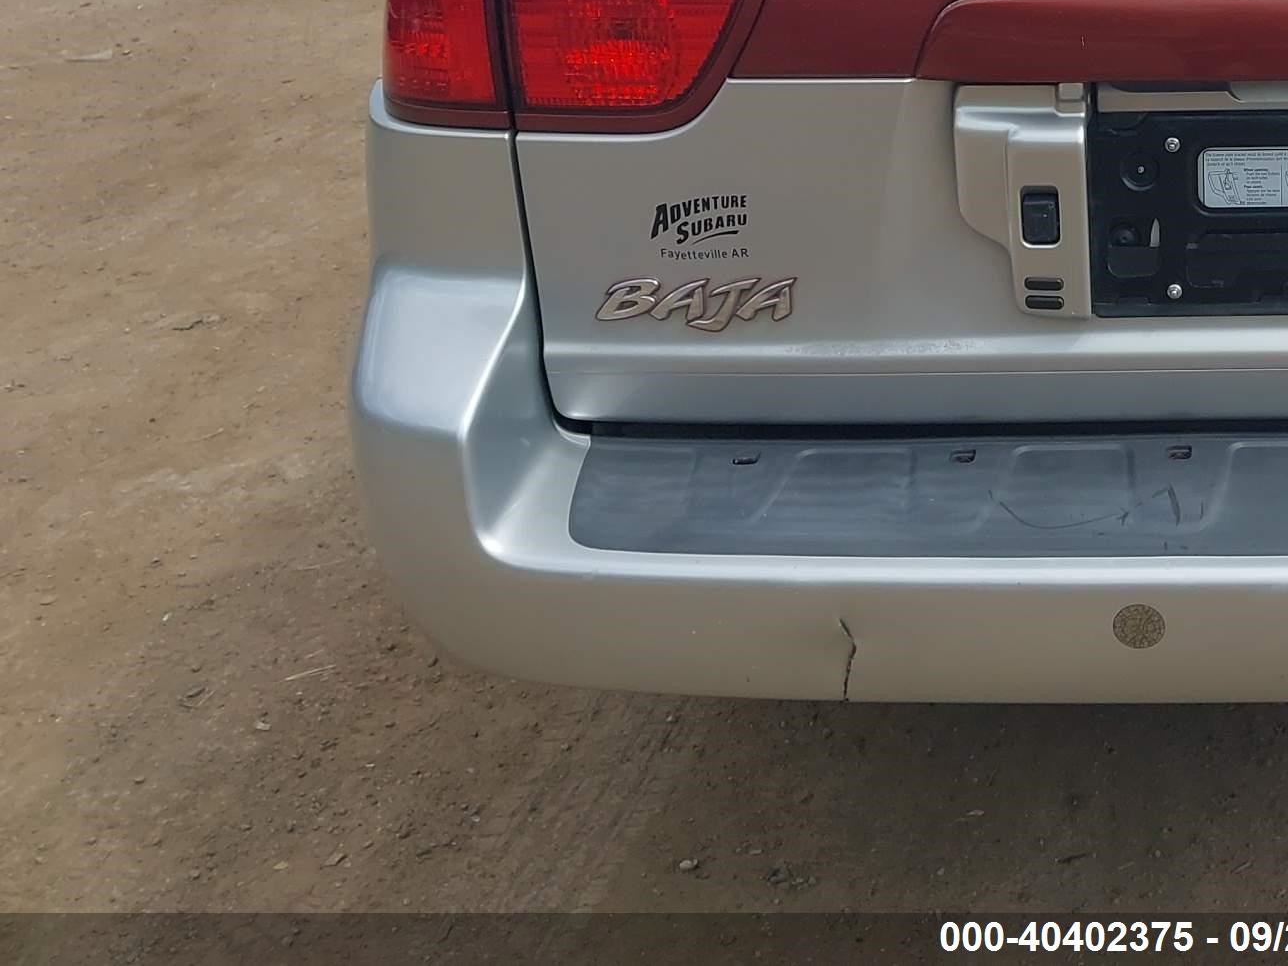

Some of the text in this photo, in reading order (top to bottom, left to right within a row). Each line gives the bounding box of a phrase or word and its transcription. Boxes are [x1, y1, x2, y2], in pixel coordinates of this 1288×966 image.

[650, 194, 748, 240] ADVENTURE
[676, 213, 748, 245] SUBARU
[660, 247, 750, 261] Fayetteville AR
[595, 276, 798, 333] BAJA
